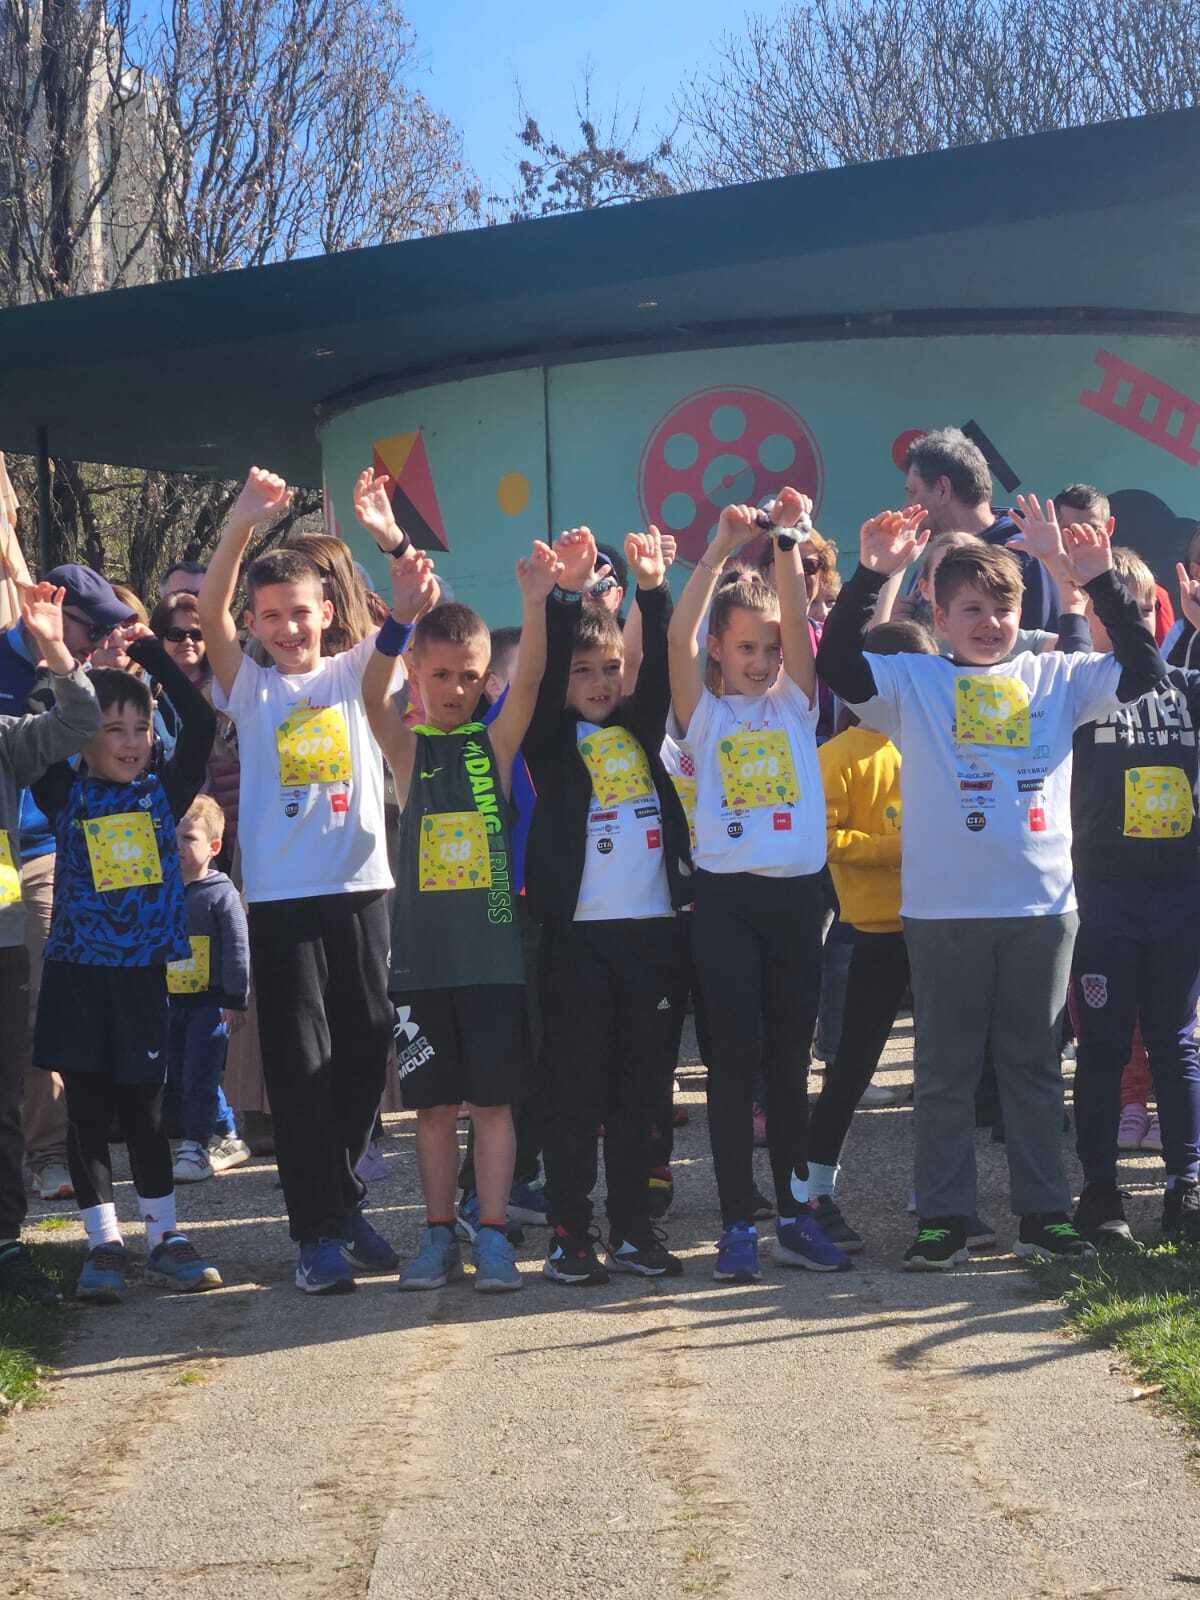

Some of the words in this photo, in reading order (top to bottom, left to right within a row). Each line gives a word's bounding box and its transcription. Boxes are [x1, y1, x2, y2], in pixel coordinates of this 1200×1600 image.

[1128, 728, 1169, 746] CREW
[438, 839, 473, 862] 138
[398, 1045, 436, 1081] MOUR
